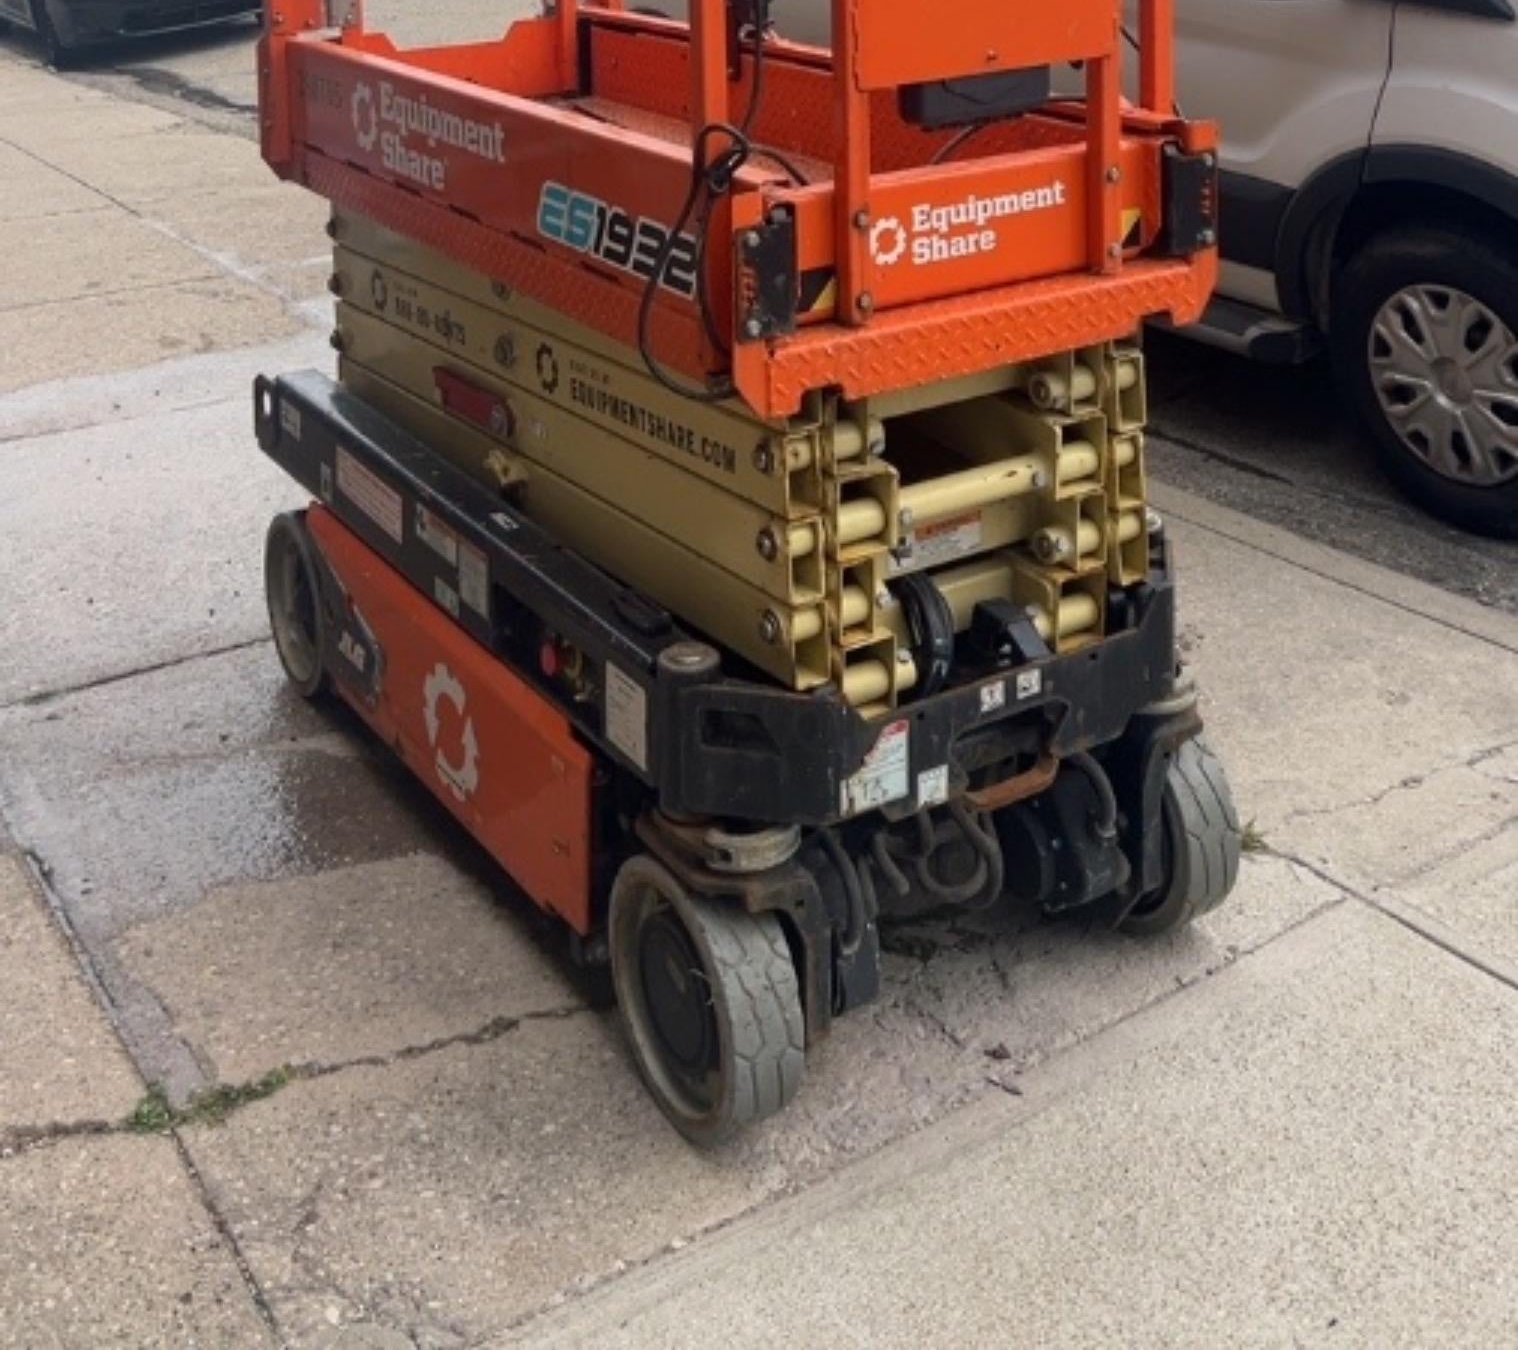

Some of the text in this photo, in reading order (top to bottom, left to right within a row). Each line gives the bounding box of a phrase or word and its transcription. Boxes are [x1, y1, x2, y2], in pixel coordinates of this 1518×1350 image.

[379, 80, 506, 163] Equipment
[380, 130, 445, 191] Share
[537, 180, 698, 300] ES1932
[911, 179, 1066, 232] Equipment
[911, 229, 997, 265] Share
[569, 377, 736, 475] EQUIPMENTSHARE.COM
